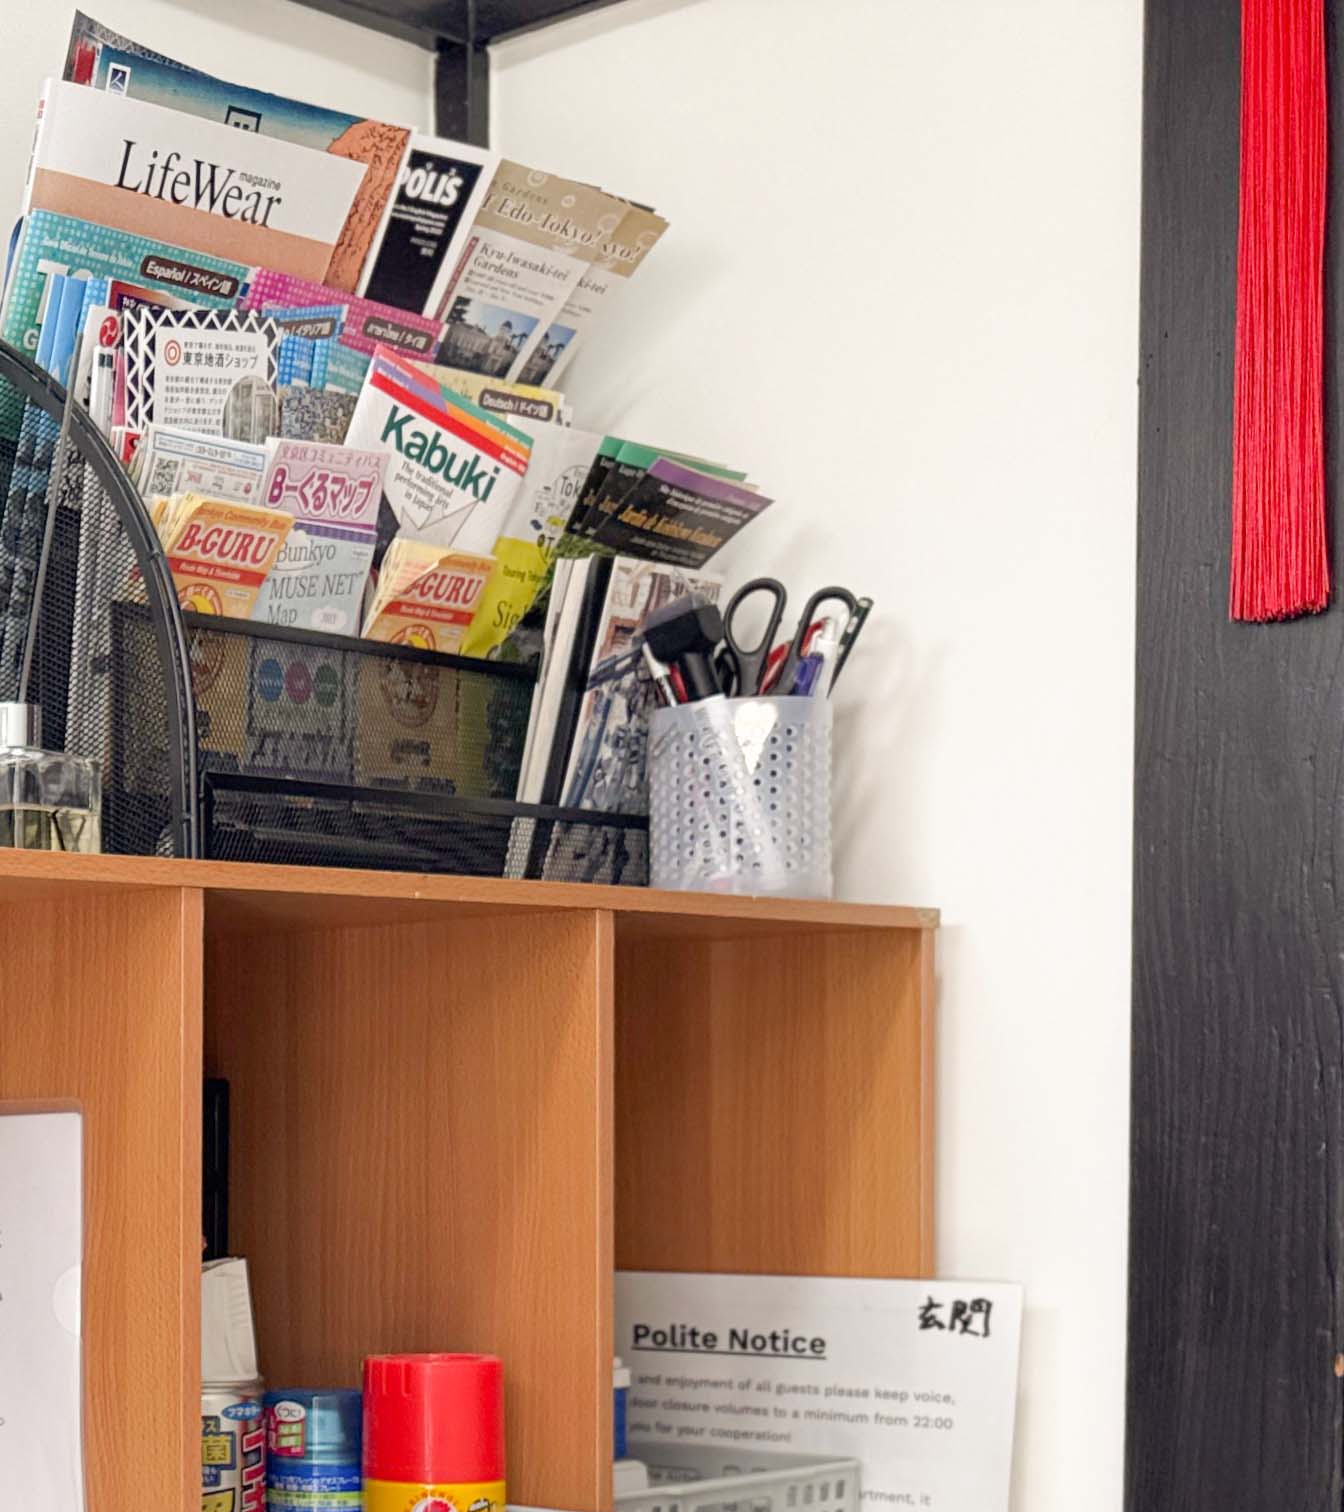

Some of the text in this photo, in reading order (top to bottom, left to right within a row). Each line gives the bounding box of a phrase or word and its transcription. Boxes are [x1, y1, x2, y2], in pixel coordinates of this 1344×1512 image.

[114, 138, 282, 228] LifeWear
[239, 171, 282, 192] magazine
[496, 197, 602, 246] Edo-Tokyo!
[146, 260, 185, 282] Español
[183, 351, 259, 370] 東京地酒ショップ
[380, 404, 501, 504] Kabuki
[276, 540, 336, 566] Bunkyo
[268, 604, 297, 625] Map
[633, 1323, 827, 1354] Polite Notice
[637, 1374, 956, 1406] and enjoyment of all guests please keep voice,
[662, 1398, 709, 1413] closure
[714, 1401, 768, 1417] volumes
[773, 1405, 788, 1418] to
[791, 1410, 800, 1420] a
[804, 1407, 869, 1424] minimum
[873, 1411, 909, 1426] from
[912, 1415, 954, 1430] 22:00
[654, 1419, 674, 1434] for
[676, 1424, 704, 1439] your
[709, 1425, 792, 1443] cooperation!
[920, 1494, 932, 1507] it
